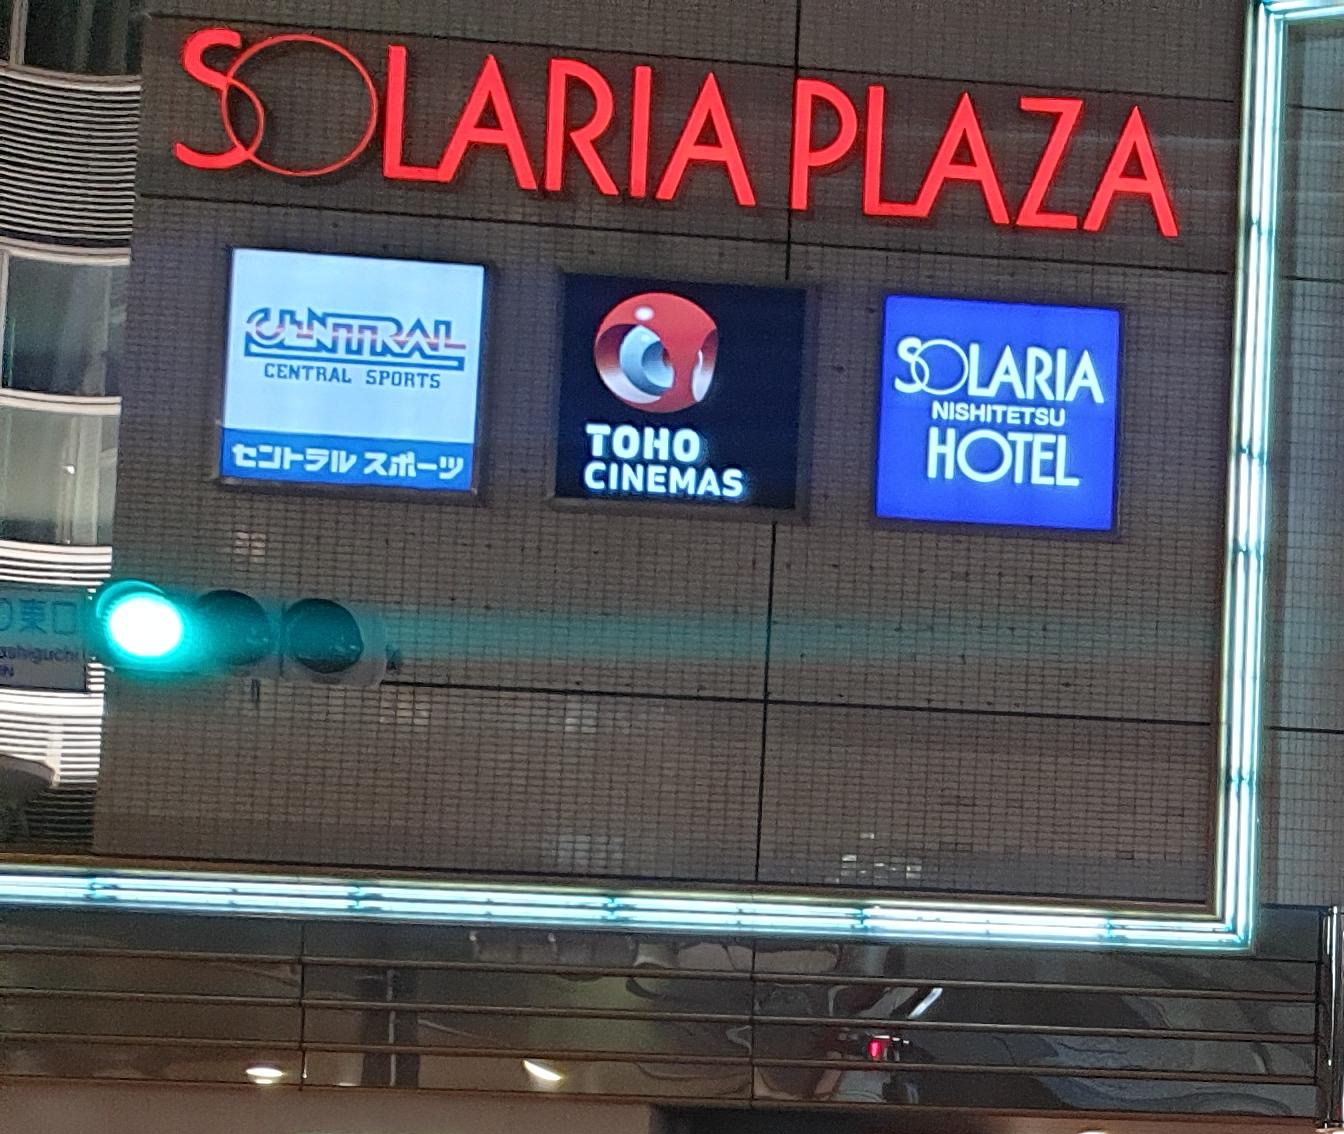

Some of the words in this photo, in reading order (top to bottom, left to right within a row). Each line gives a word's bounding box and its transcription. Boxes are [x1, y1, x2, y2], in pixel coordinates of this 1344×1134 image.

[175, 28, 758, 208] SOLARIA
[790, 78, 1181, 240] PLAZA
[244, 306, 467, 372] CENTRAL
[264, 363, 352, 384] CENTRAL
[366, 369, 441, 389] SPORTS
[895, 337, 1105, 403] SOLARIA
[931, 401, 1066, 428] NISHITETSU
[232, 443, 357, 474] セントラル
[363, 451, 464, 480] スポーツ
[585, 423, 702, 463] TOHO
[927, 427, 1080, 487] HOTEL
[584, 461, 744, 498] CINEMAS
